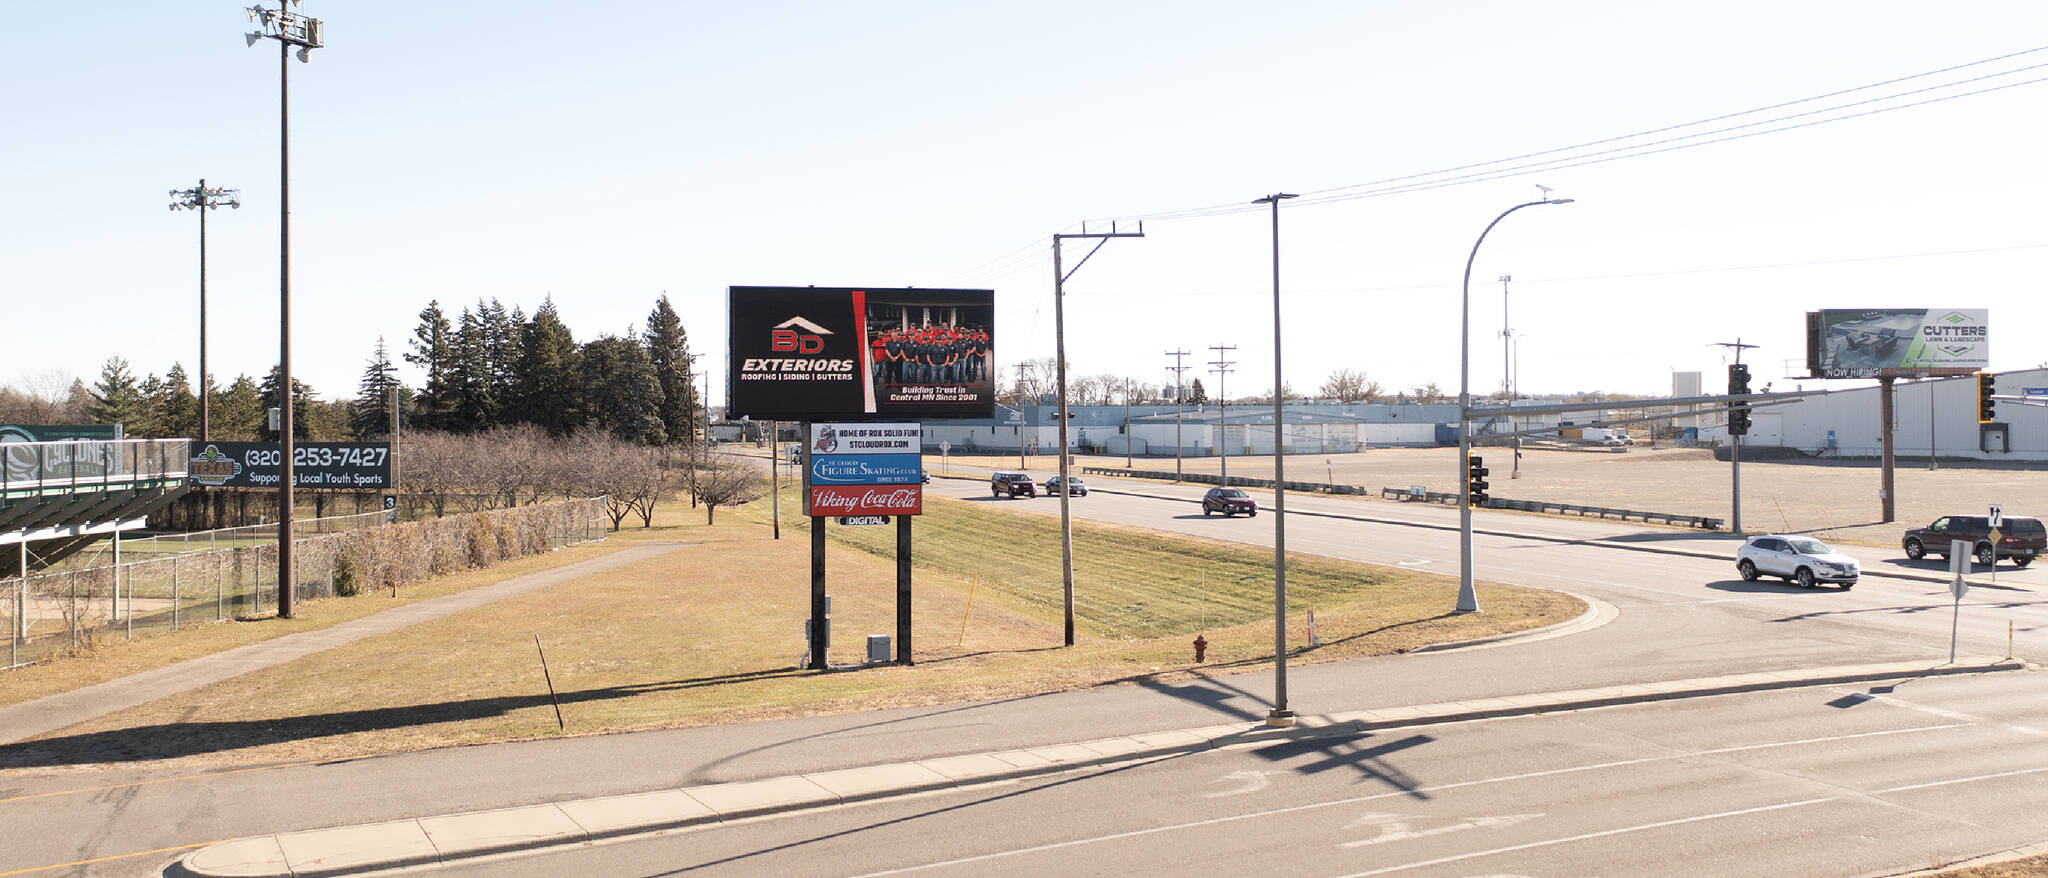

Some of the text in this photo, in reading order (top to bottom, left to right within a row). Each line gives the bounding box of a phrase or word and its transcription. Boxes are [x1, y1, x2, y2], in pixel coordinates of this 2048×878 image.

[1923, 326, 1987, 336] CUTTERS
[772, 329, 824, 354] BD
[742, 359, 854, 372] EXTERIORS
[741, 373, 853, 381] ROOFING SIDING GUTTERS
[1826, 368, 1848, 377] NOW
[902, 386, 966, 395] Building Trust in
[839, 429, 918, 438] HOME OF ROX SOLID FUN!
[849, 440, 909, 449] STCLOUDROX.COM
[44, 437, 114, 473] CYCLONES
[245, 447, 388, 467] (320 253-7427
[191, 461, 233, 475] TEXAS
[821, 464, 858, 476] FIGURE
[860, 462, 900, 475] SKATING
[249, 471, 383, 486] Supporg Local Youth Sports
[386, 497, 395, 508] 3
[812, 489, 919, 512] Viking Coca-Cola
